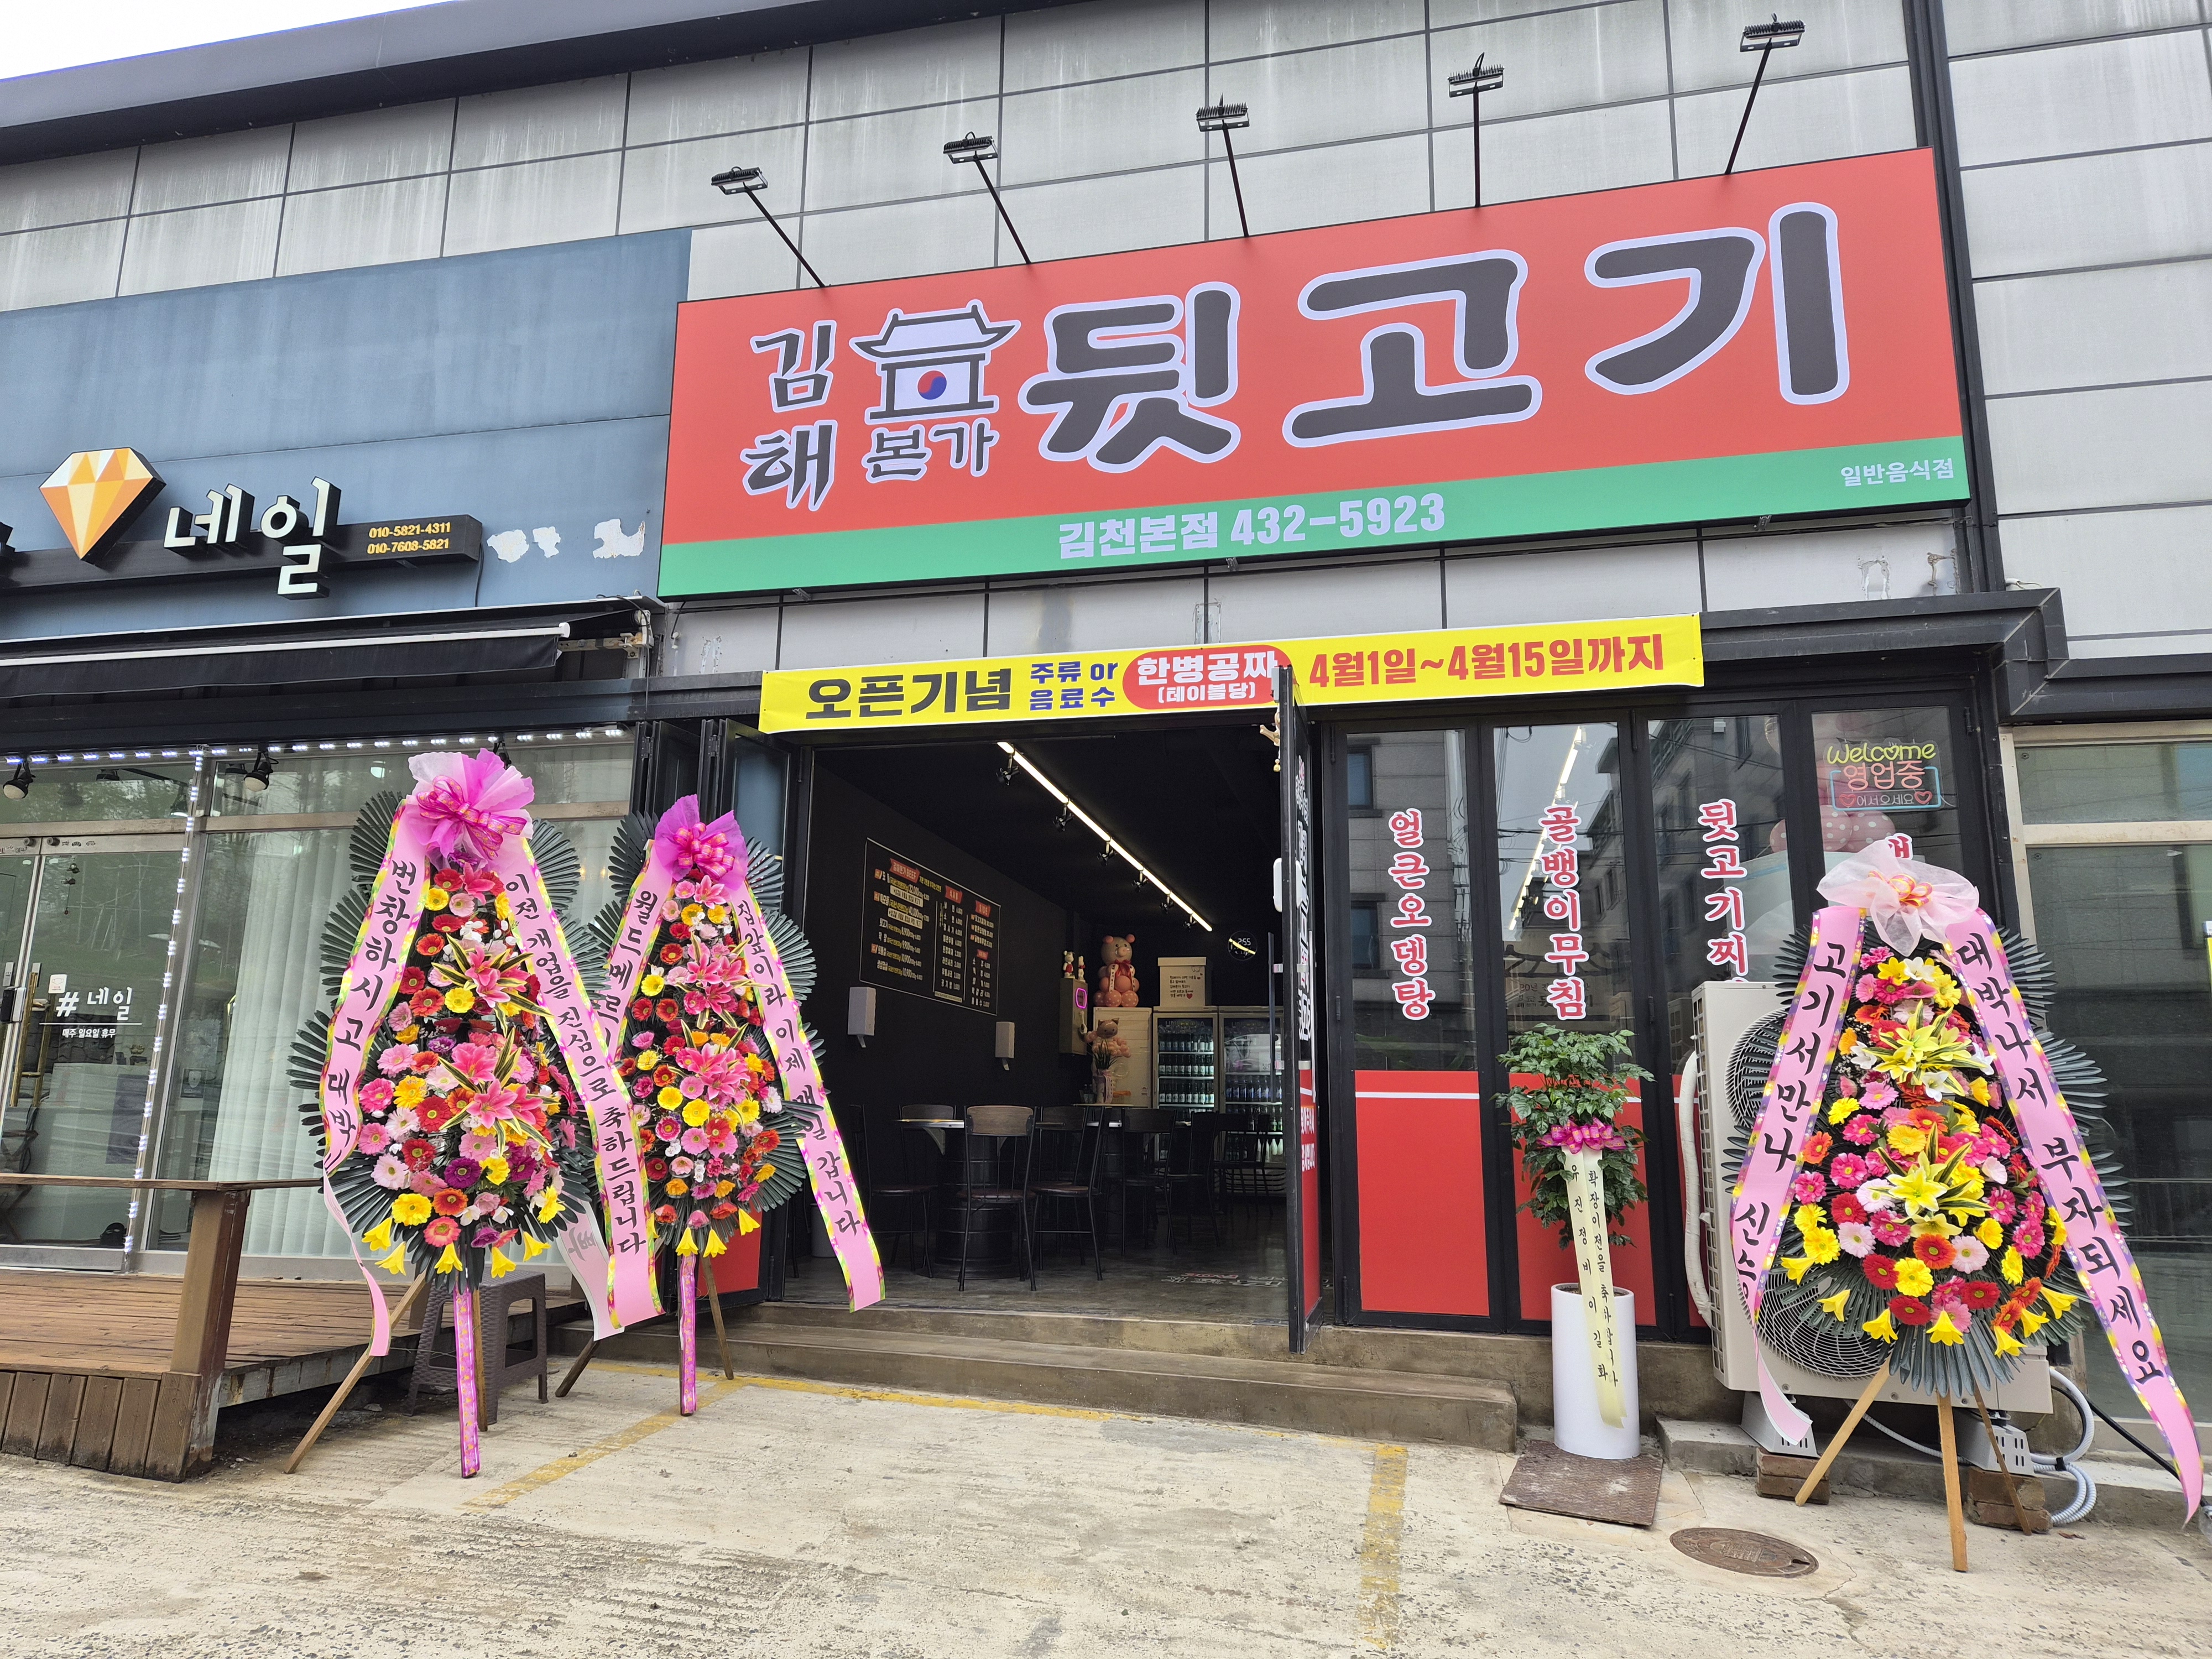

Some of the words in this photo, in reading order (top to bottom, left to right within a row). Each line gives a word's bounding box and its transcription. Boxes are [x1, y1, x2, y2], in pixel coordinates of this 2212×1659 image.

[1018, 202, 1849, 473] 뒷고기
[864, 418, 998, 483] 본가
[1840, 456, 1954, 487] 일반음식점
[163, 476, 338, 597] 네일
[367, 538, 450, 555] 010-7608-5821
[368, 521, 451, 539] 010-5821-4311
[1058, 509, 1217, 560] 김천본점
[1230, 492, 1446, 546] 432-5923
[1030, 661, 1082, 685] 주류
[1090, 661, 1119, 682] or
[1136, 649, 1277, 687] 한병공짜
[1309, 633, 1664, 687] 4월1일~4월15일까지
[805, 668, 1011, 720] 오픈기념
[1029, 686, 1115, 712] 음료수
[1827, 742, 1936, 765] Welcome
[1843, 760, 1925, 791] 영업중
[978, 903, 988, 916] SIDE
[1388, 808, 1436, 1020] 얼큰오뎅탕
[1538, 804, 1589, 1020] 골뱅이무침
[1698, 798, 1748, 982] 뒷고기찌
[334, 859, 417, 1052] 번창하시고
[87, 986, 133, 1021] 네일
[62, 1028, 76, 1038] 매주
[78, 1029, 100, 1039] 일요일
[101, 1028, 116, 1039] 휴무
[505, 873, 540, 920] 이전
[526, 928, 572, 1000] 개업을
[557, 1006, 618, 1102] 진심으로
[598, 1106, 648, 1256] 축하드립니다
[775, 1019, 806, 1073] 이제
[817, 1150, 861, 1237] 갑니다
[1301, 1143, 1316, 1172] 감사합니다
[1955, 932, 2048, 1110] 대박나서
[2041, 1136, 2164, 1385] 부자되세요
[1588, 1170, 1606, 1273] 확장이전을
